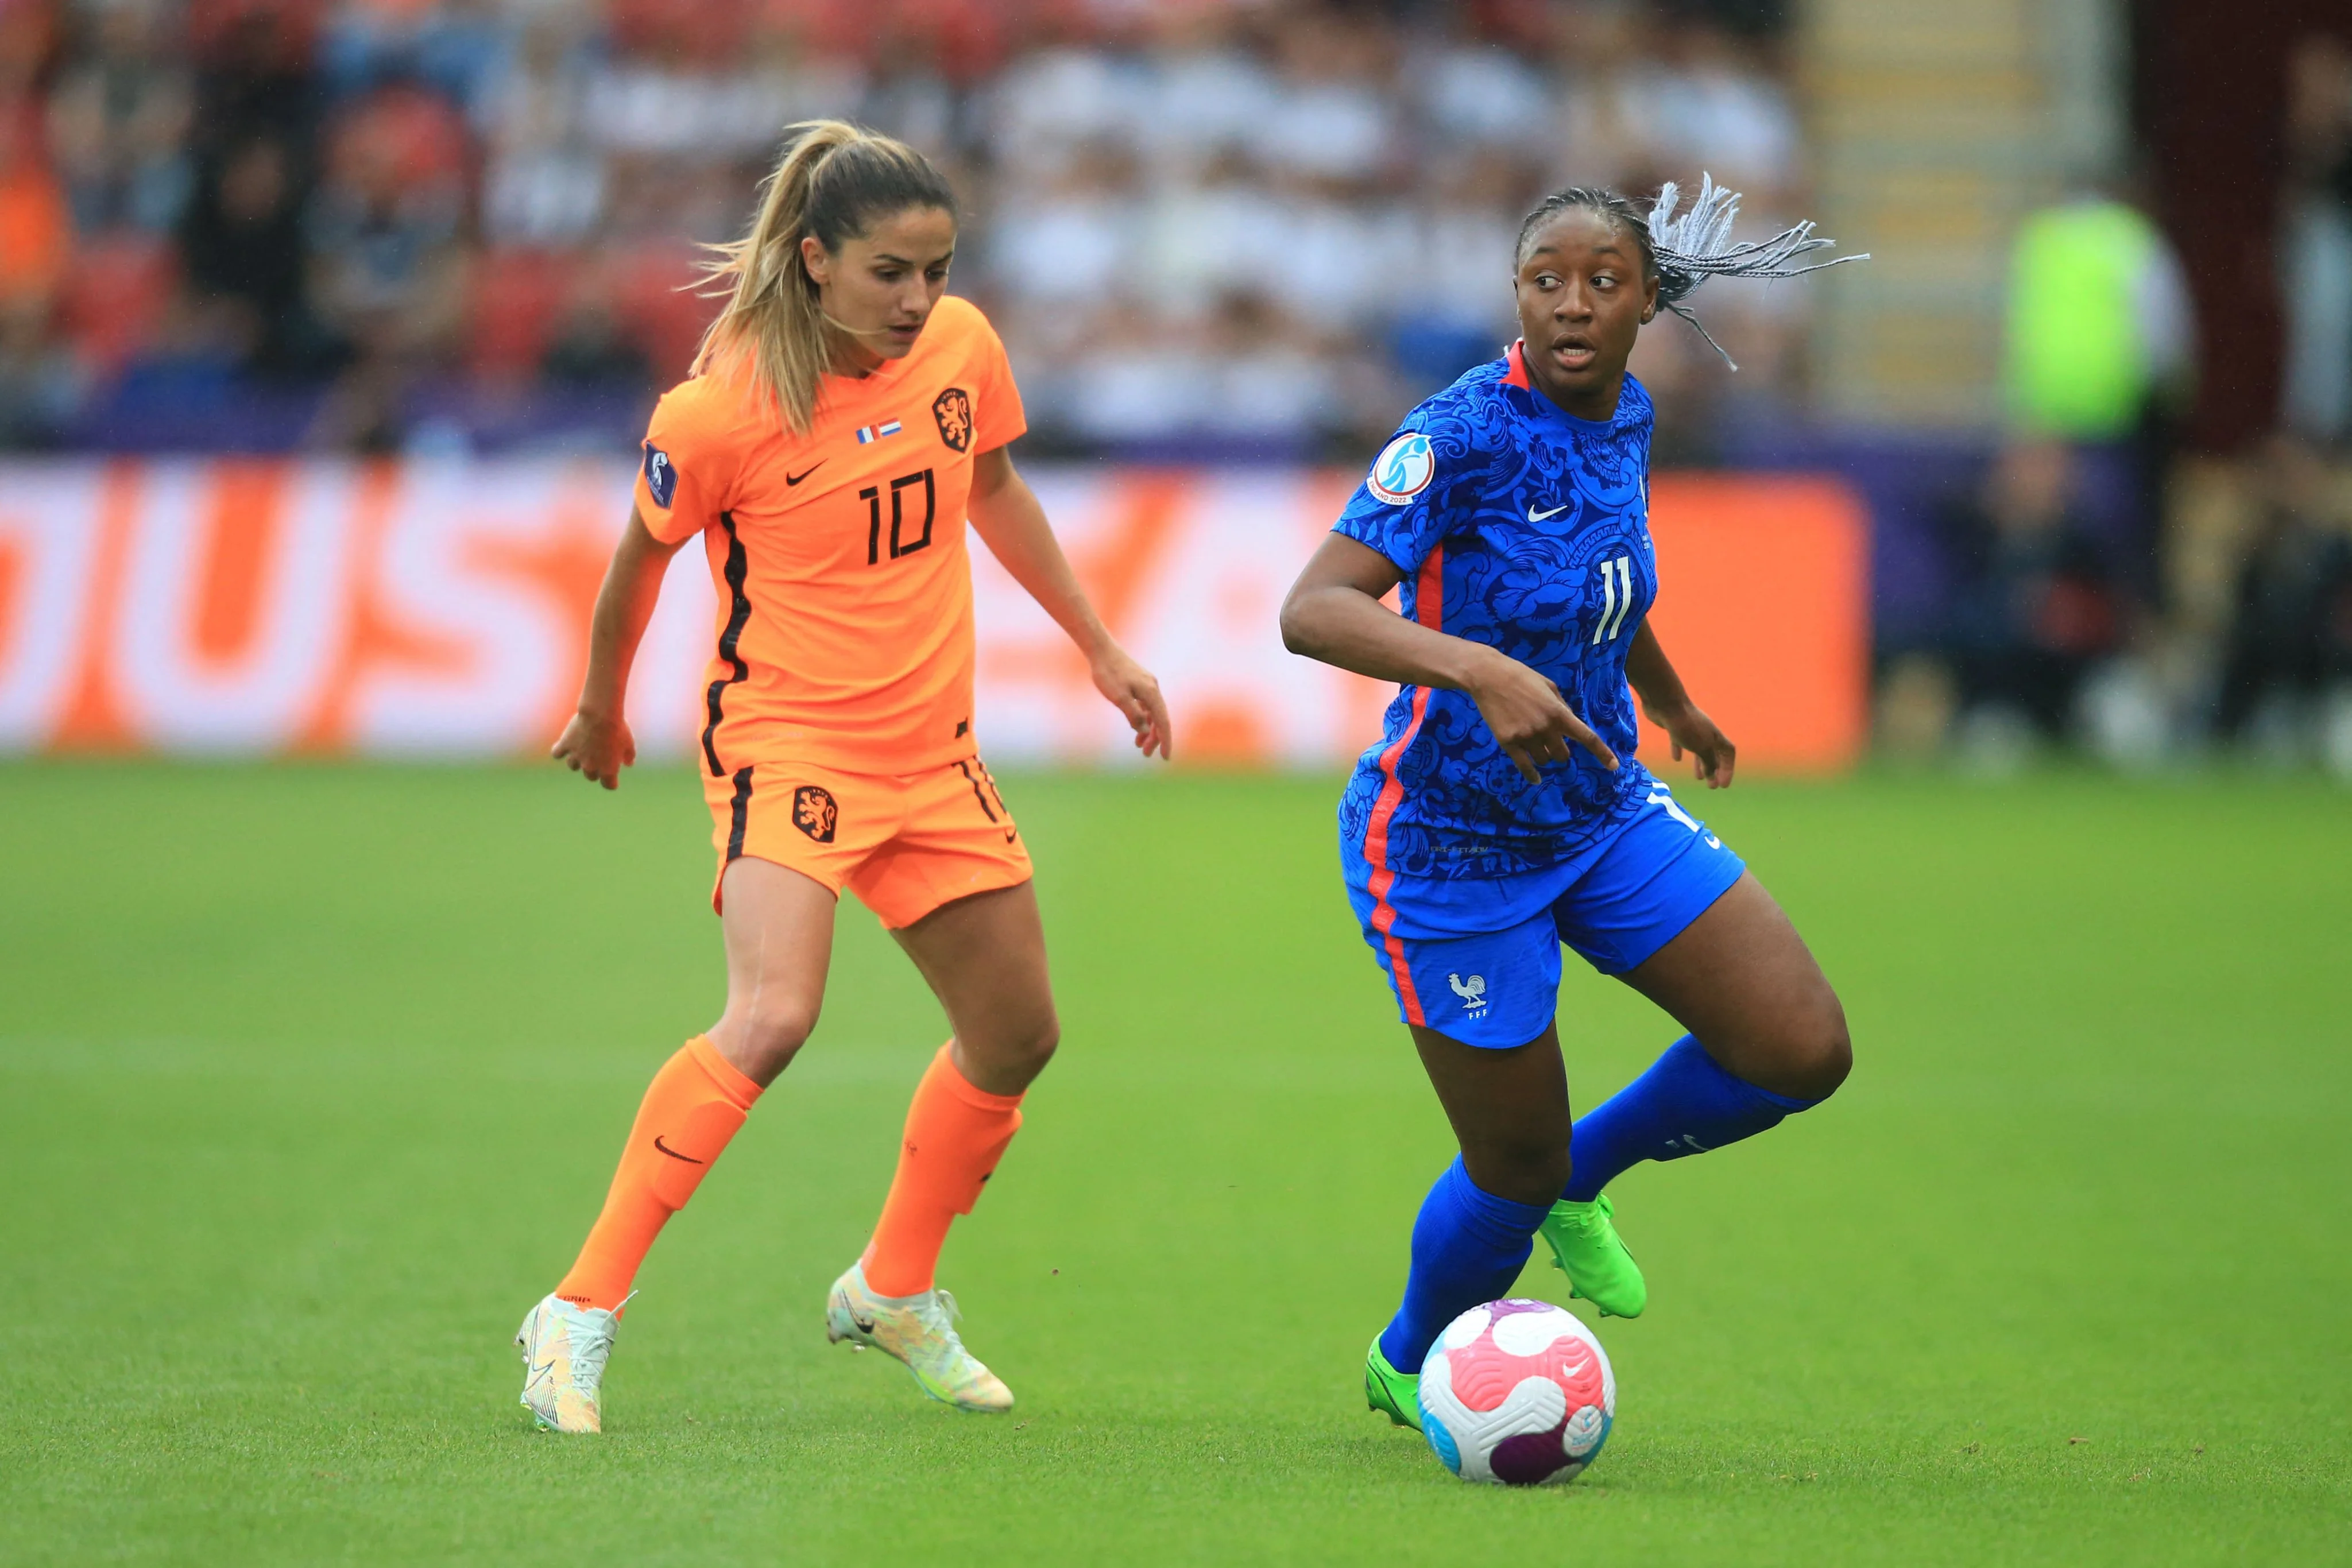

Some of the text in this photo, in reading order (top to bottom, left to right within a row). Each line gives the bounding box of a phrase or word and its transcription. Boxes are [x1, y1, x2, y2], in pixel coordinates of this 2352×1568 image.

[859, 468, 935, 565] 10
[1369, 481, 1388, 501] ENGLAND
[1593, 556, 1631, 645] 11
[1468, 1009, 1487, 1020] FFF
